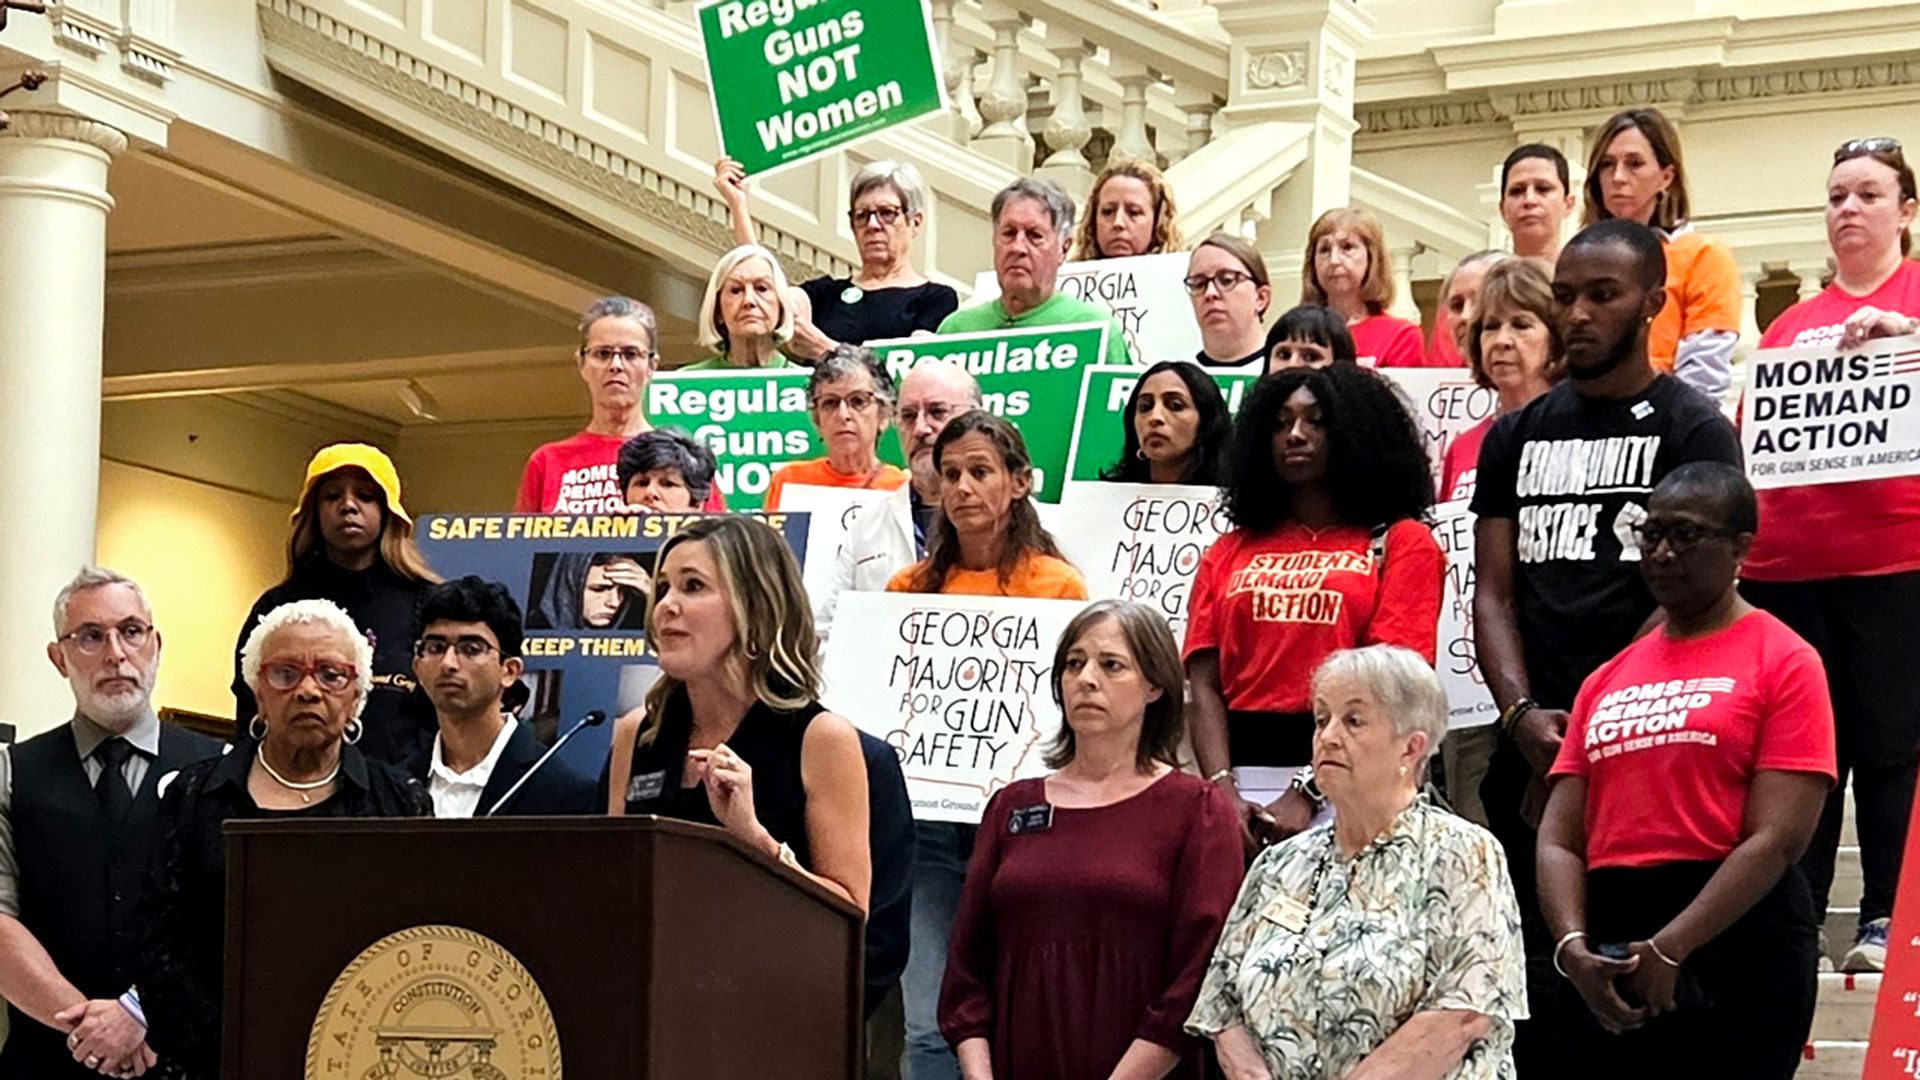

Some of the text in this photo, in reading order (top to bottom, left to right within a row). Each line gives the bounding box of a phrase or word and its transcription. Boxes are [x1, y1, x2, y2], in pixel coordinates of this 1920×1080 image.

[764, 10, 864, 65] Guns
[777, 44, 860, 104] NOT
[756, 80, 903, 152] Women
[1060, 272, 1137, 302] ORGIA
[1755, 355, 1869, 388] MOMS
[649, 381, 807, 422] Regula
[1754, 384, 1910, 421] DEMAND
[694, 424, 809, 455] Guns
[1752, 418, 1889, 454] ACTION
[715, 462, 790, 494] NO
[1517, 436, 1661, 497] COMMUNITY
[1751, 448, 1920, 476] FOR GUN SENSE IN AMERICA
[560, 480, 622, 499] DEMA
[429, 517, 503, 540] SAFE
[506, 516, 640, 539] FIREARM
[1517, 502, 1603, 563] JUSTICE
[1112, 541, 1205, 576] MAJO
[1251, 552, 1371, 574] STUDENTS
[1120, 577, 1162, 598] FOR
[1228, 571, 1323, 595] DEMAND
[1255, 592, 1339, 622] ACTION
[579, 638, 645, 656] THEM
[900, 611, 1039, 650] GEORGIA
[889, 655, 1051, 694] MAJORITY
[1588, 693, 1712, 727] DEMAND
[1597, 679, 1684, 709] MOMS
[900, 692, 1025, 734] FOR GUN
[1585, 709, 1688, 749] ACTION
[886, 729, 1008, 770] SAFETY
[327, 943, 546, 1077] TATE OF GEORGI
[393, 981, 483, 1015] CONSTITUTION
